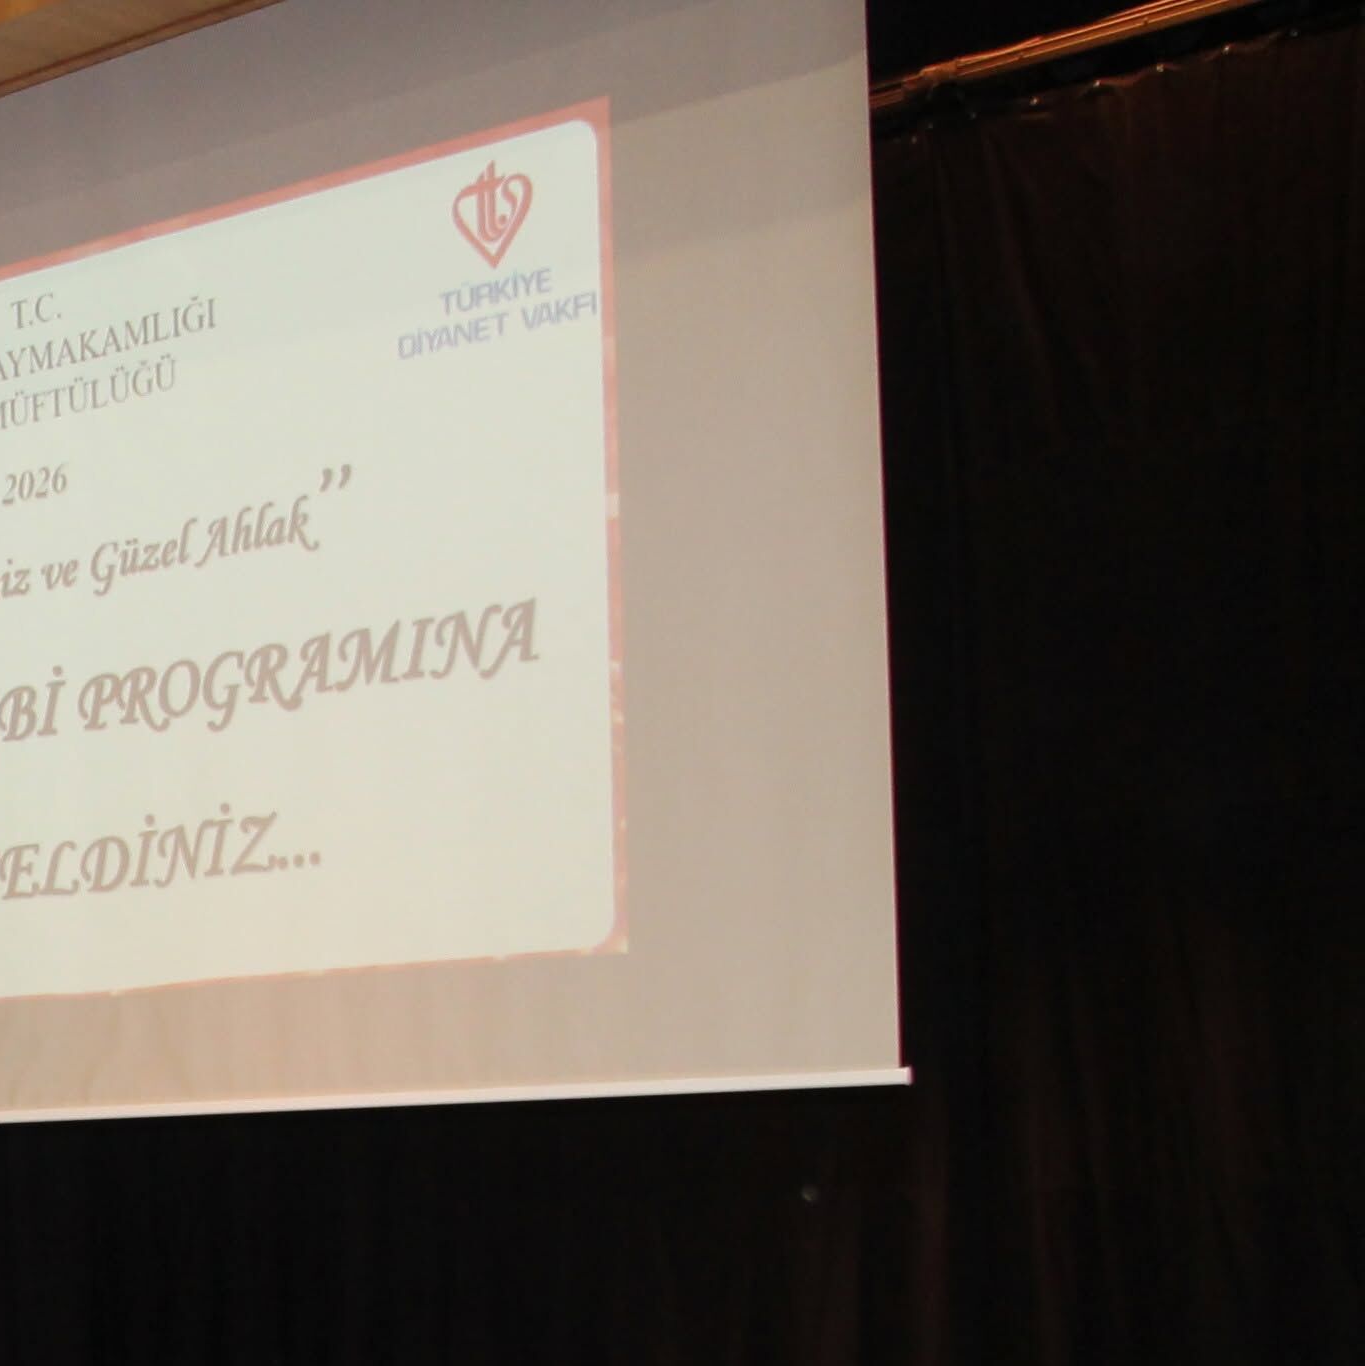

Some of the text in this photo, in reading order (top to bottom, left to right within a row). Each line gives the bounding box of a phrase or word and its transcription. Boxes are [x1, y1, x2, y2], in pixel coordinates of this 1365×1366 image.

[10, 292, 62, 330] T.C.
[439, 268, 552, 317] TÜRKİYE
[397, 291, 598, 361] DİYANET VAKFI
[1, 461, 68, 506] 2026
[40, 558, 79, 592] ve
[90, 517, 191, 597] Güzel
[76, 596, 541, 734] PROGRAMINA
